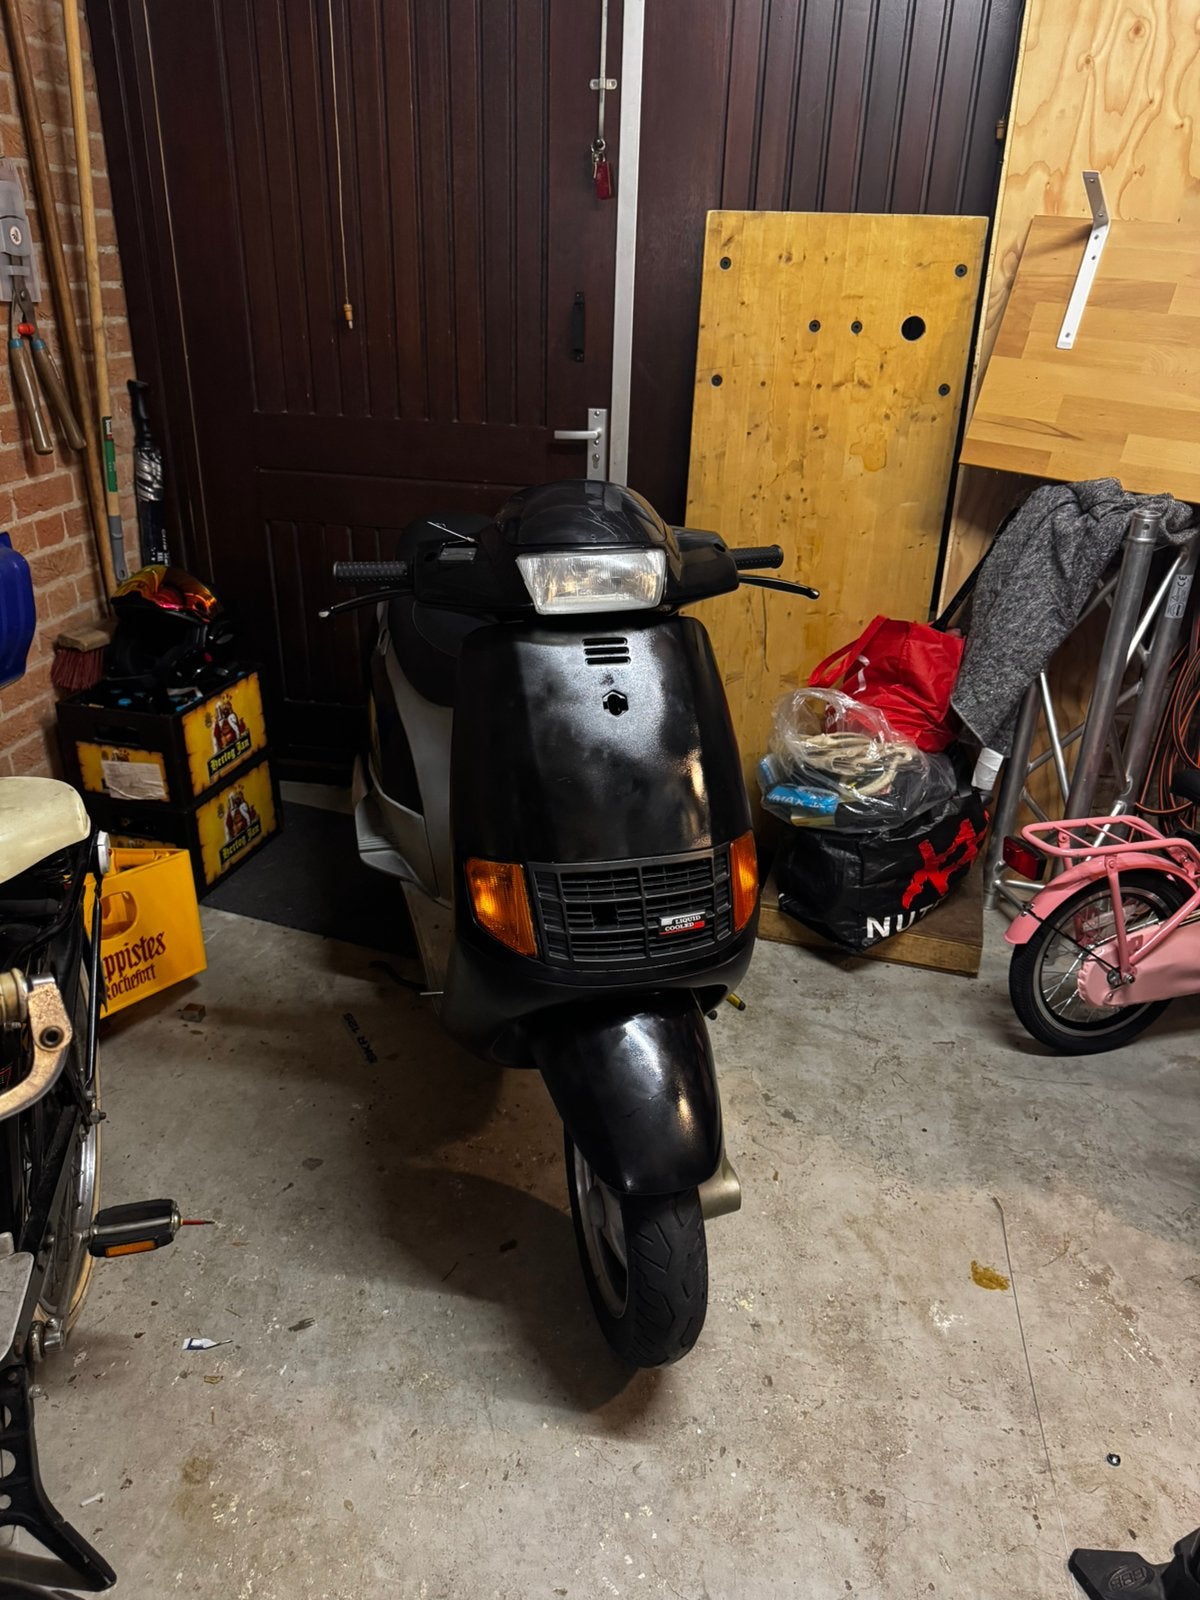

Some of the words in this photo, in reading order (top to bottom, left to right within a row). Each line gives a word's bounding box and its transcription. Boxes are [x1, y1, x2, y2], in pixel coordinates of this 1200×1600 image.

[210, 748, 236, 772] Hertog
[664, 922, 695, 932] COOLED
[674, 914, 702, 925] LIQUID
[102, 931, 167, 983] ppistes
